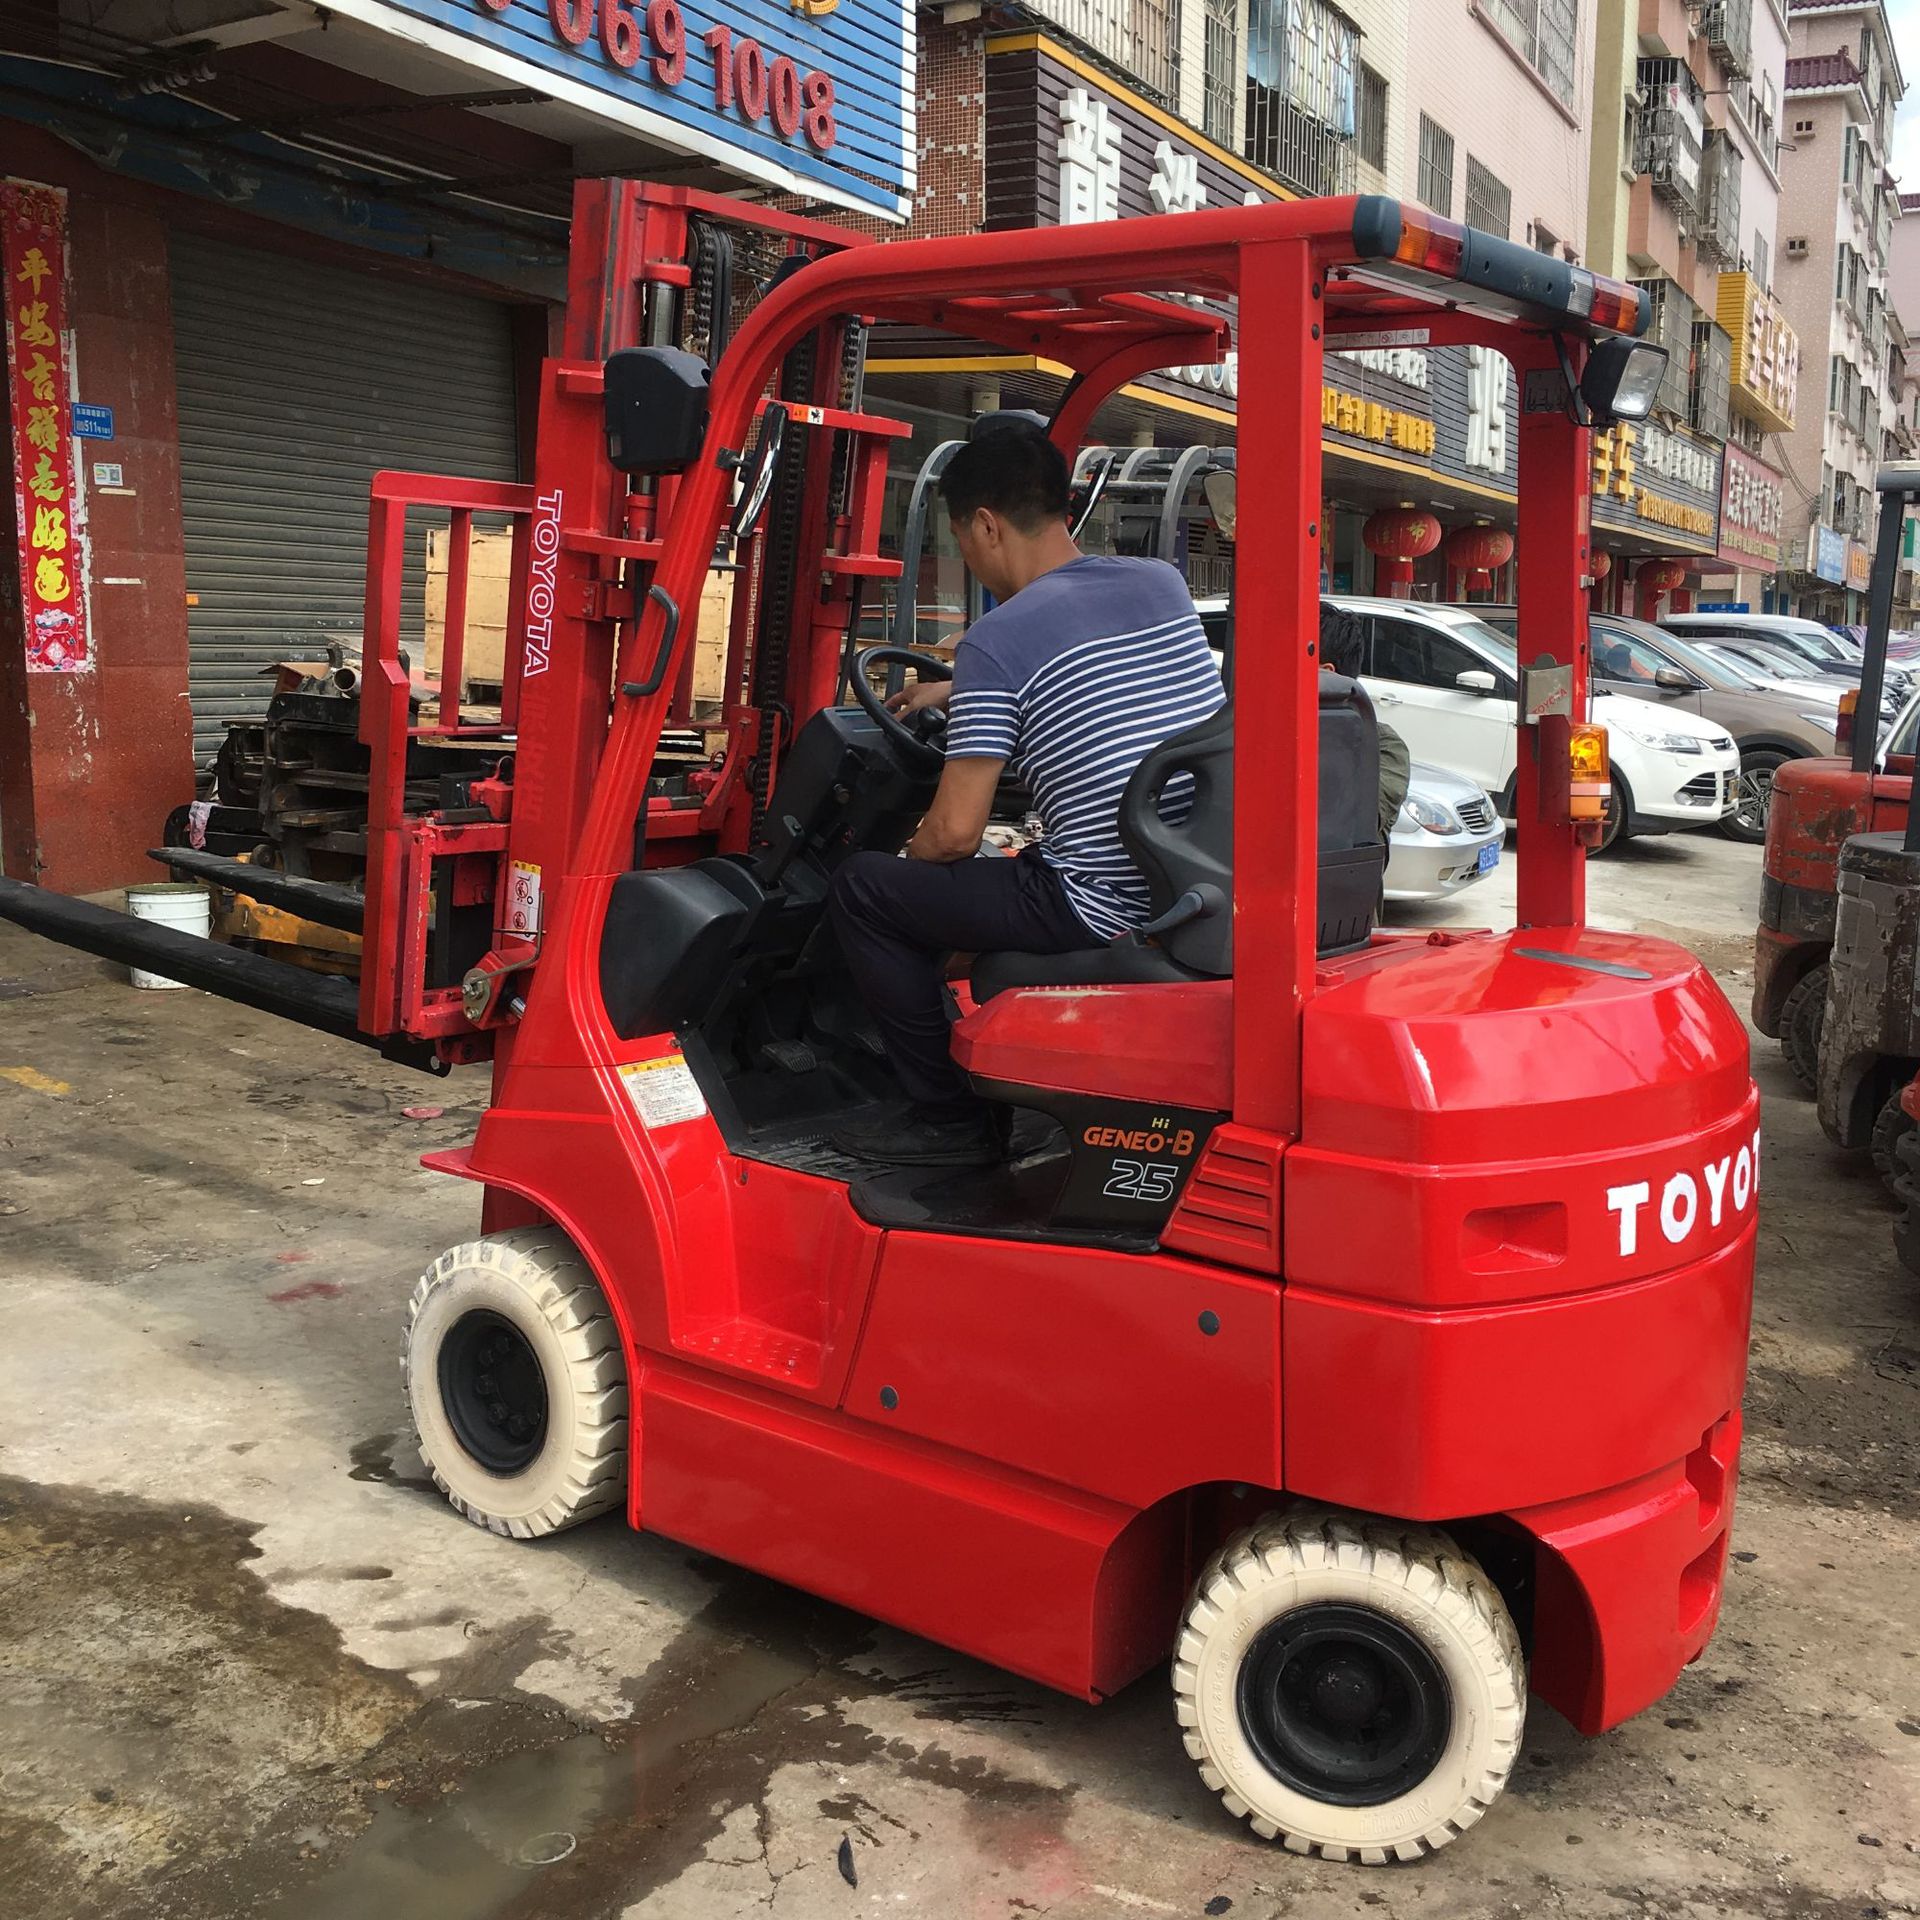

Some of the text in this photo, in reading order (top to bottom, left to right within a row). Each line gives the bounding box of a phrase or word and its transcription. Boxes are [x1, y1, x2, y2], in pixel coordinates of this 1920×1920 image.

[704, 24, 836, 150] 1008
[523, 489, 563, 678] TOYOTA
[1082, 1126, 1196, 1157] GENEO-B
[1151, 1116, 1171, 1129] Hi
[1103, 1158, 1179, 1202] 25
